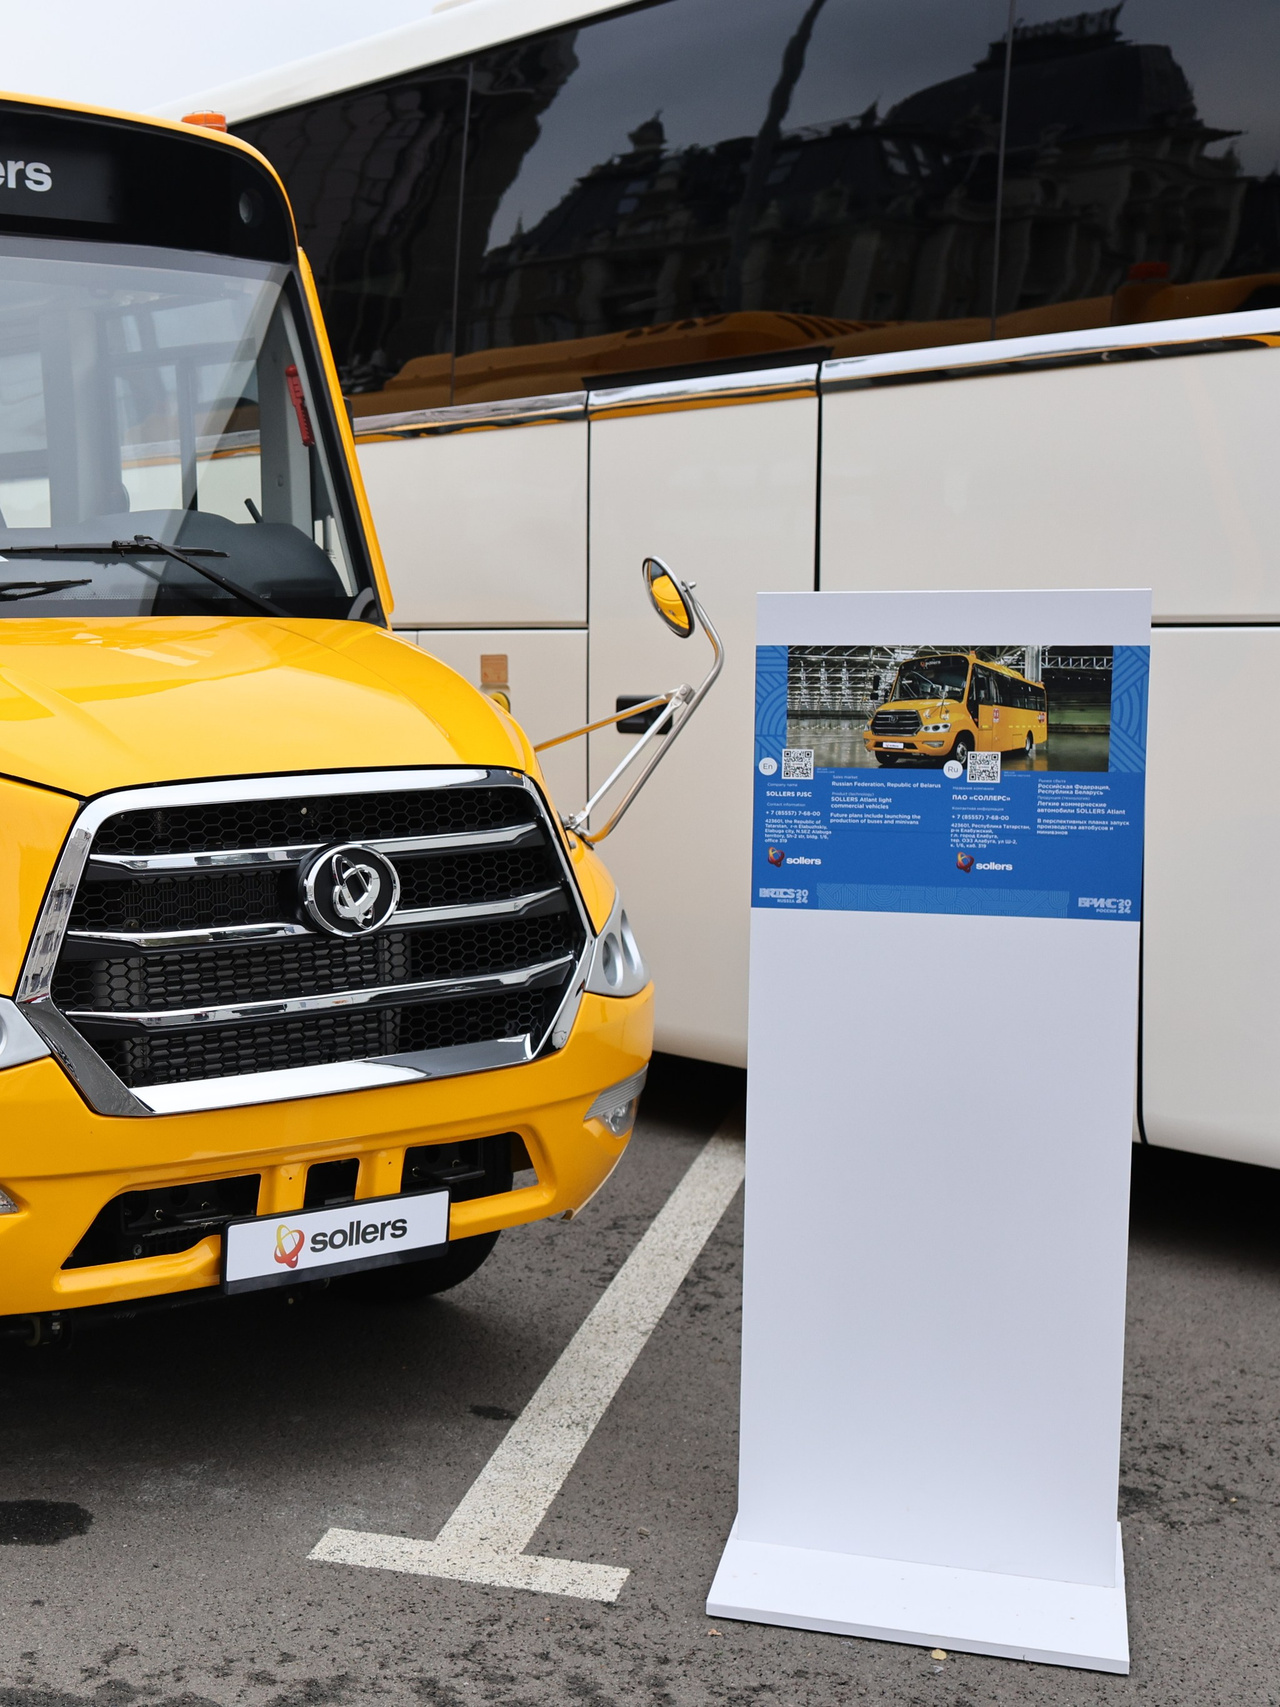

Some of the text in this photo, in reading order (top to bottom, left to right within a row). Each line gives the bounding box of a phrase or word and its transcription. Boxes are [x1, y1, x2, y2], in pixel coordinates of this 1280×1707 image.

[786, 856, 822, 866] sollers
[975, 861, 1013, 871] sollers
[759, 887, 795, 899] BRICS
[310, 1218, 408, 1253] sollers
